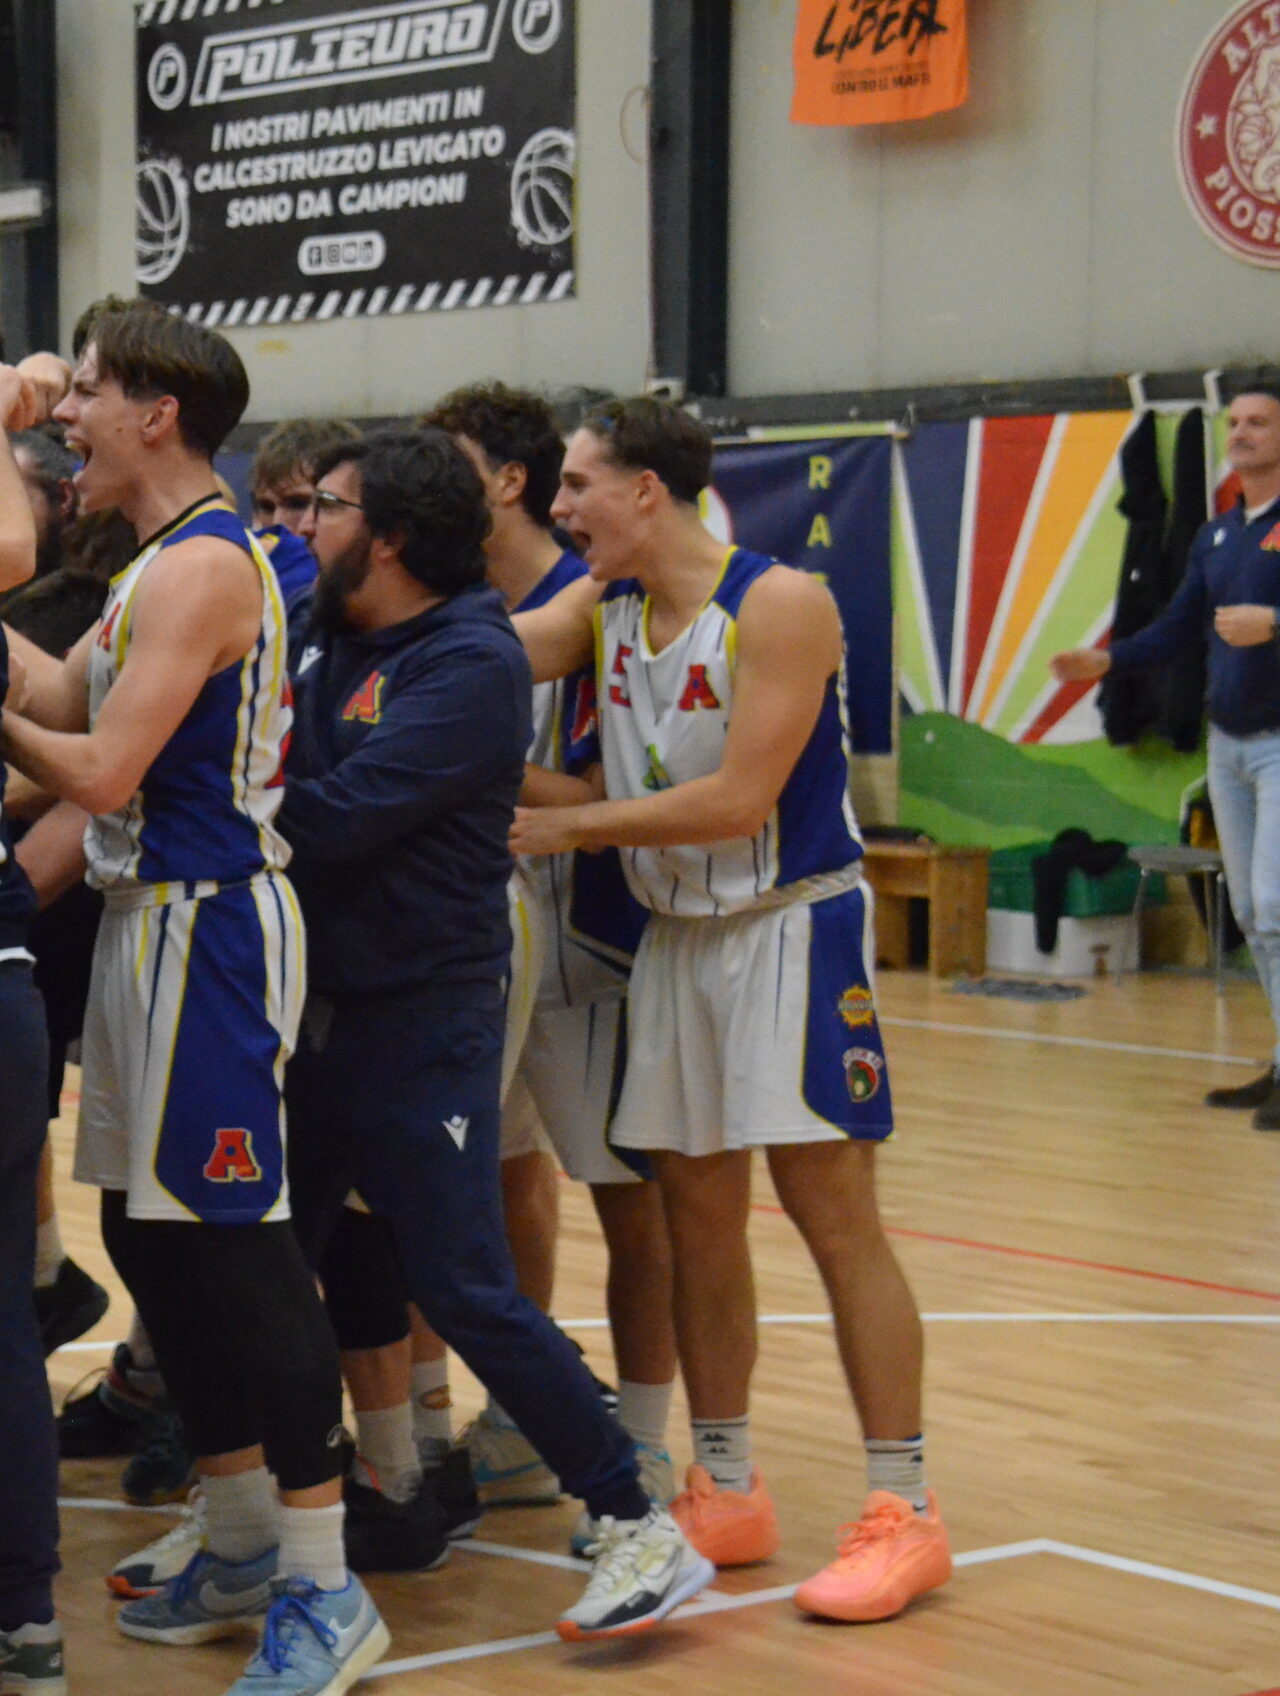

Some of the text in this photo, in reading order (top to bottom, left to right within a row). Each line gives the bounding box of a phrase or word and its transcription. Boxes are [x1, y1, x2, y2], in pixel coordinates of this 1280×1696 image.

[206, 4, 489, 100] POLIEURO
[212, 86, 485, 152] I NOSTRI PAVIMENTI IN
[194, 125, 506, 193] CALCESTRUZZO LEVIGATO
[226, 172, 467, 228] SONO DA CAMPIONI
[1204, 165, 1280, 244] PIOS
[203, 1127, 262, 1183] A
